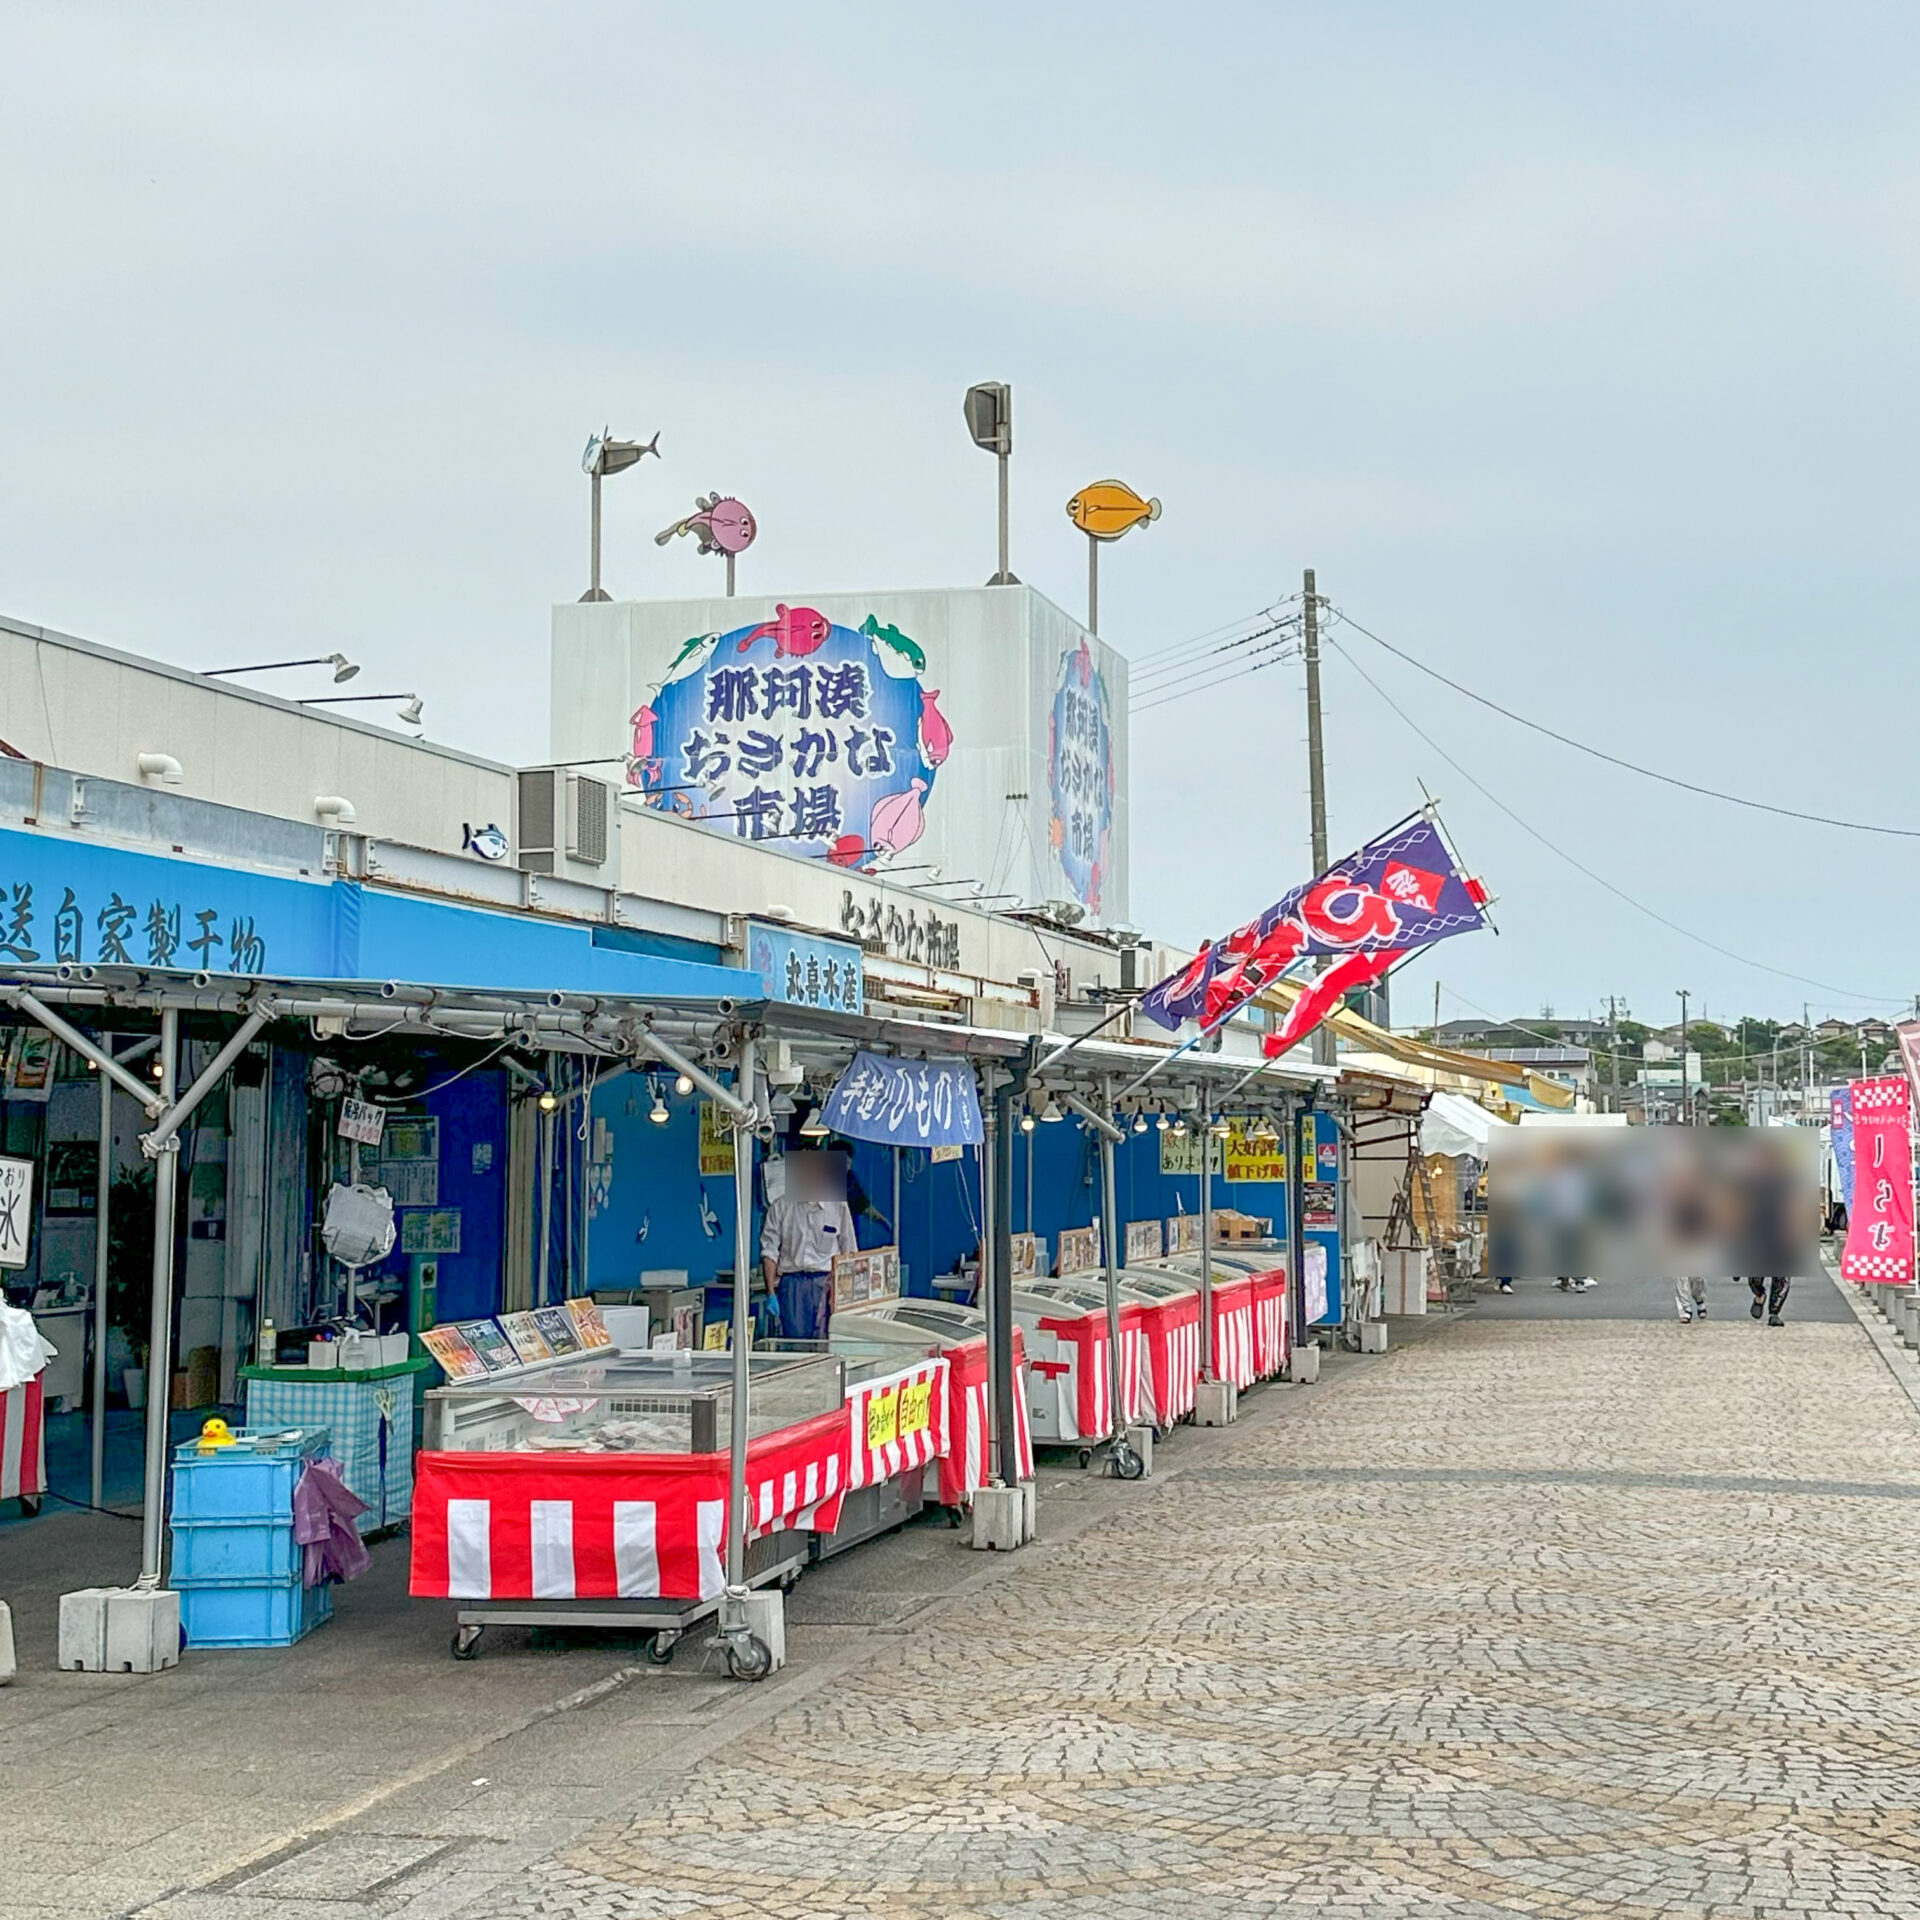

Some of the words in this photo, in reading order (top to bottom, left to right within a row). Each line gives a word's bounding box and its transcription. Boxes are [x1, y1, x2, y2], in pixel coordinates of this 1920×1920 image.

[707, 662, 870, 723] 那珂湊
[1065, 686, 1099, 752] 那珂湊
[682, 723, 896, 782] おさかな
[1060, 743, 1104, 809] おさかな
[732, 783, 843, 841] 市場
[1071, 807, 1094, 863] 市場
[0, 882, 266, 974] 送自家製干物
[841, 889, 960, 972] おさかな市場
[784, 948, 859, 1013] 丸喜水産
[840, 1064, 953, 1138] 手造りひもの
[1226, 1162, 1314, 1180] 値下げ販中
